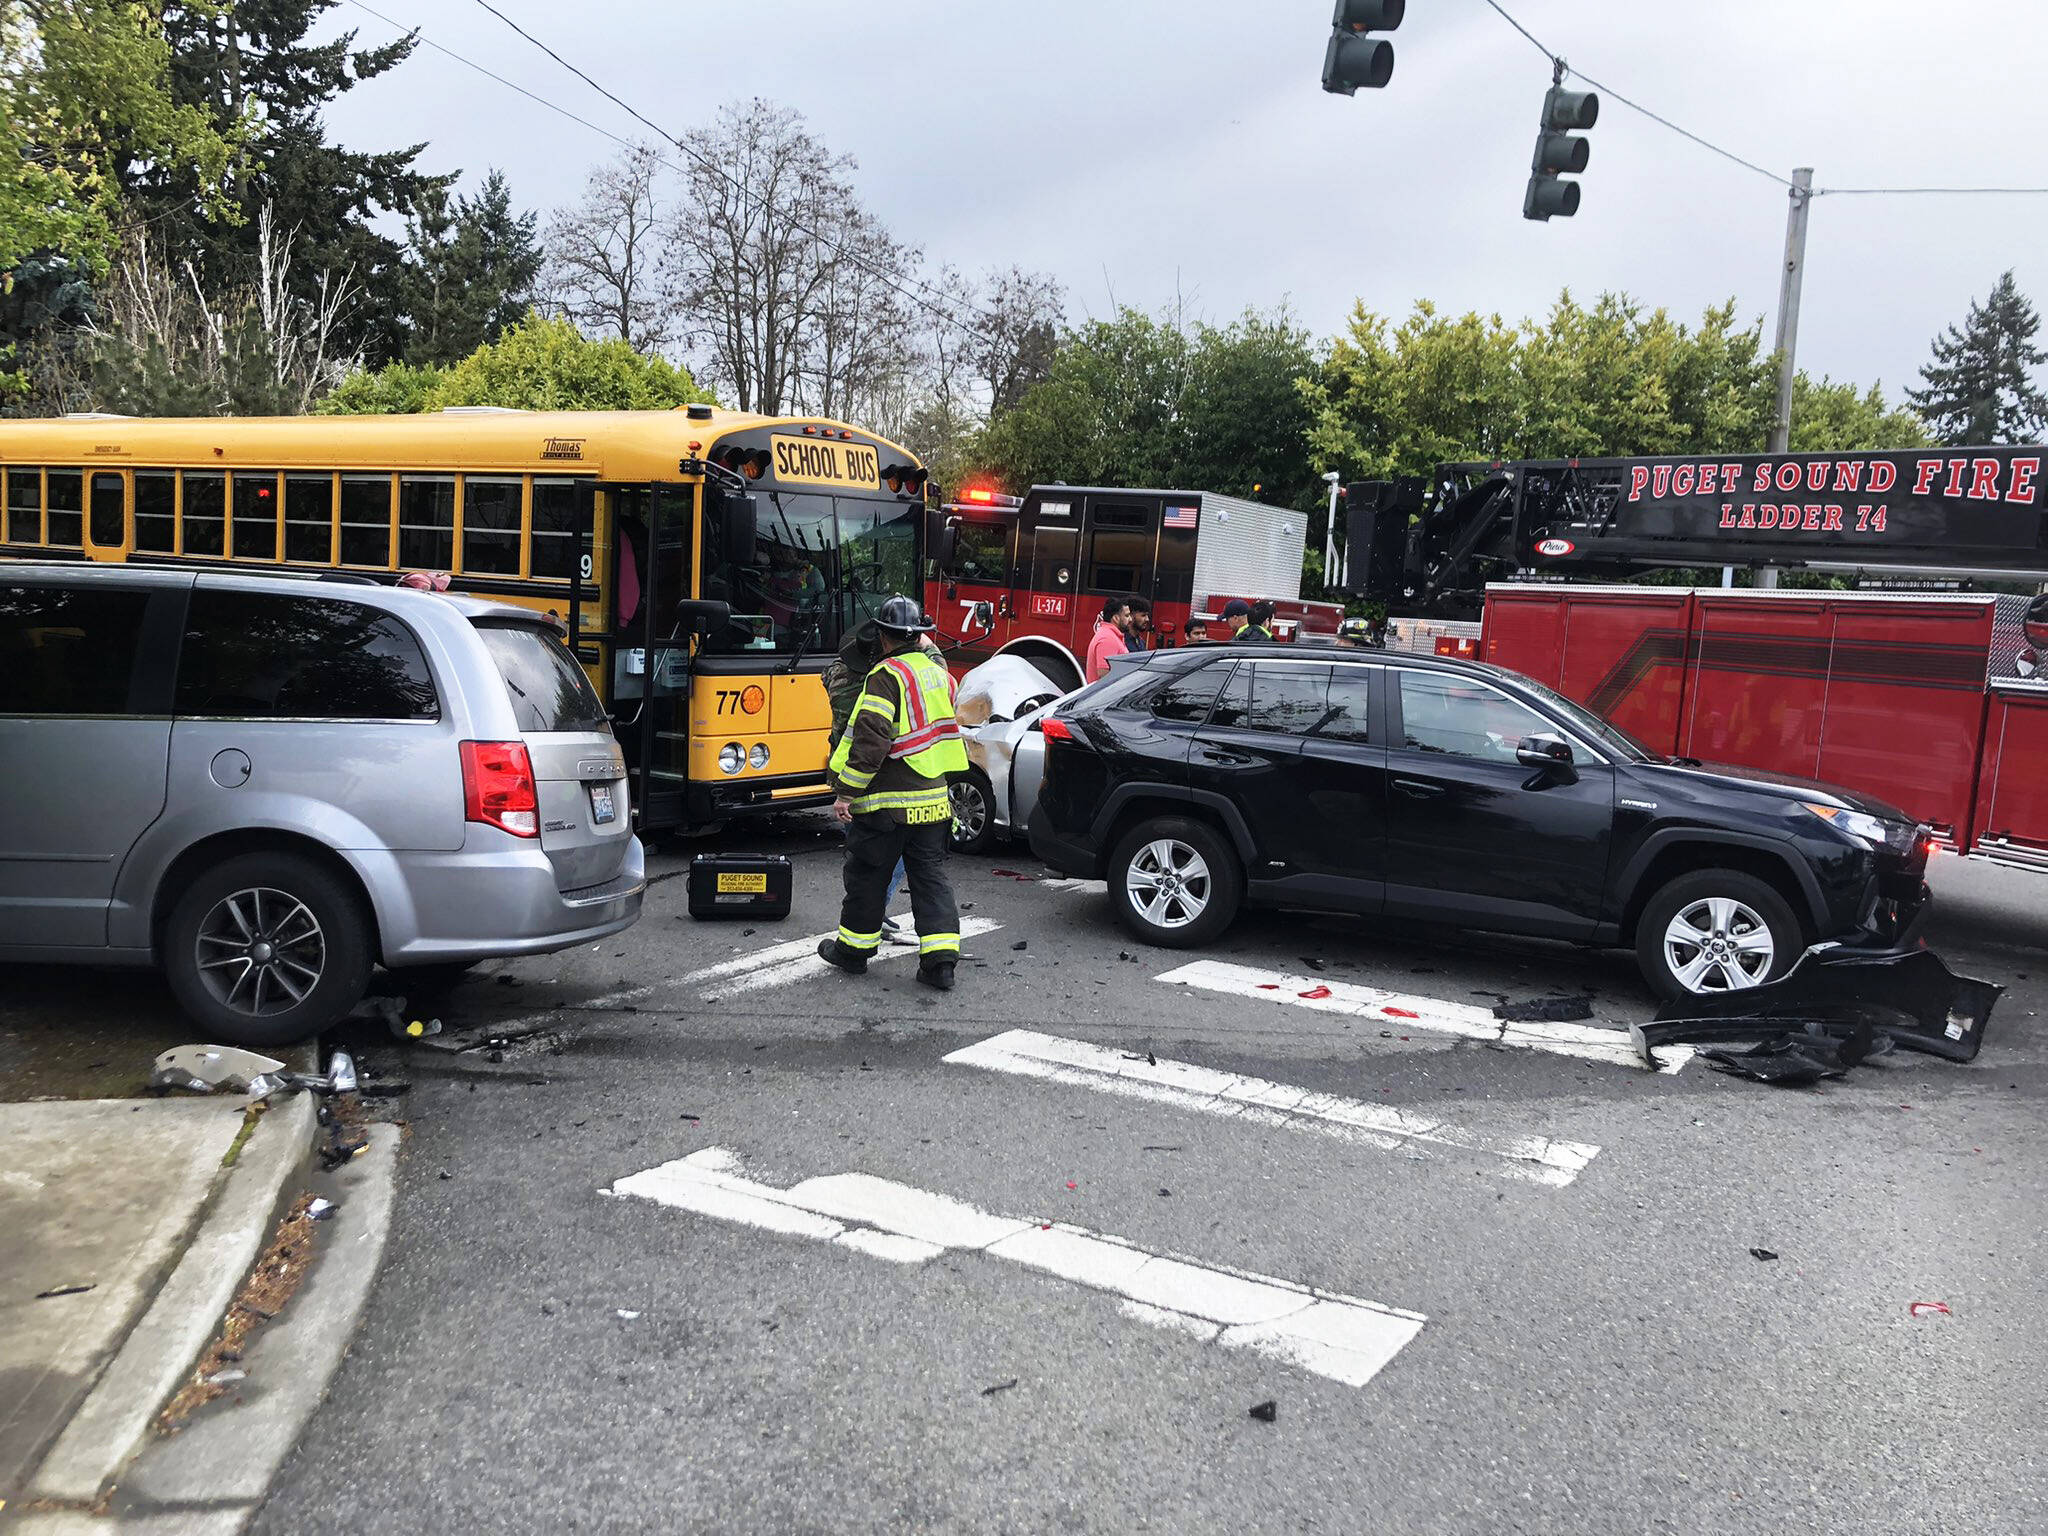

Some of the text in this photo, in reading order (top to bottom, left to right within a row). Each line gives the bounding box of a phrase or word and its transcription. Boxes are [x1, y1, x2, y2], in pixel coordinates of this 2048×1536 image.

[544, 437, 586, 452] Thomas
[777, 441, 876, 483] SCHOOL BUS
[1628, 457, 2040, 504] PUGET SOUND FIRE
[1719, 503, 1888, 532] LADDER 74
[580, 554, 593, 578] 9
[960, 599, 995, 632] 7
[1037, 598, 1062, 614] L-374
[716, 690, 741, 715] 77
[721, 874, 763, 882] PUGET SOUND
